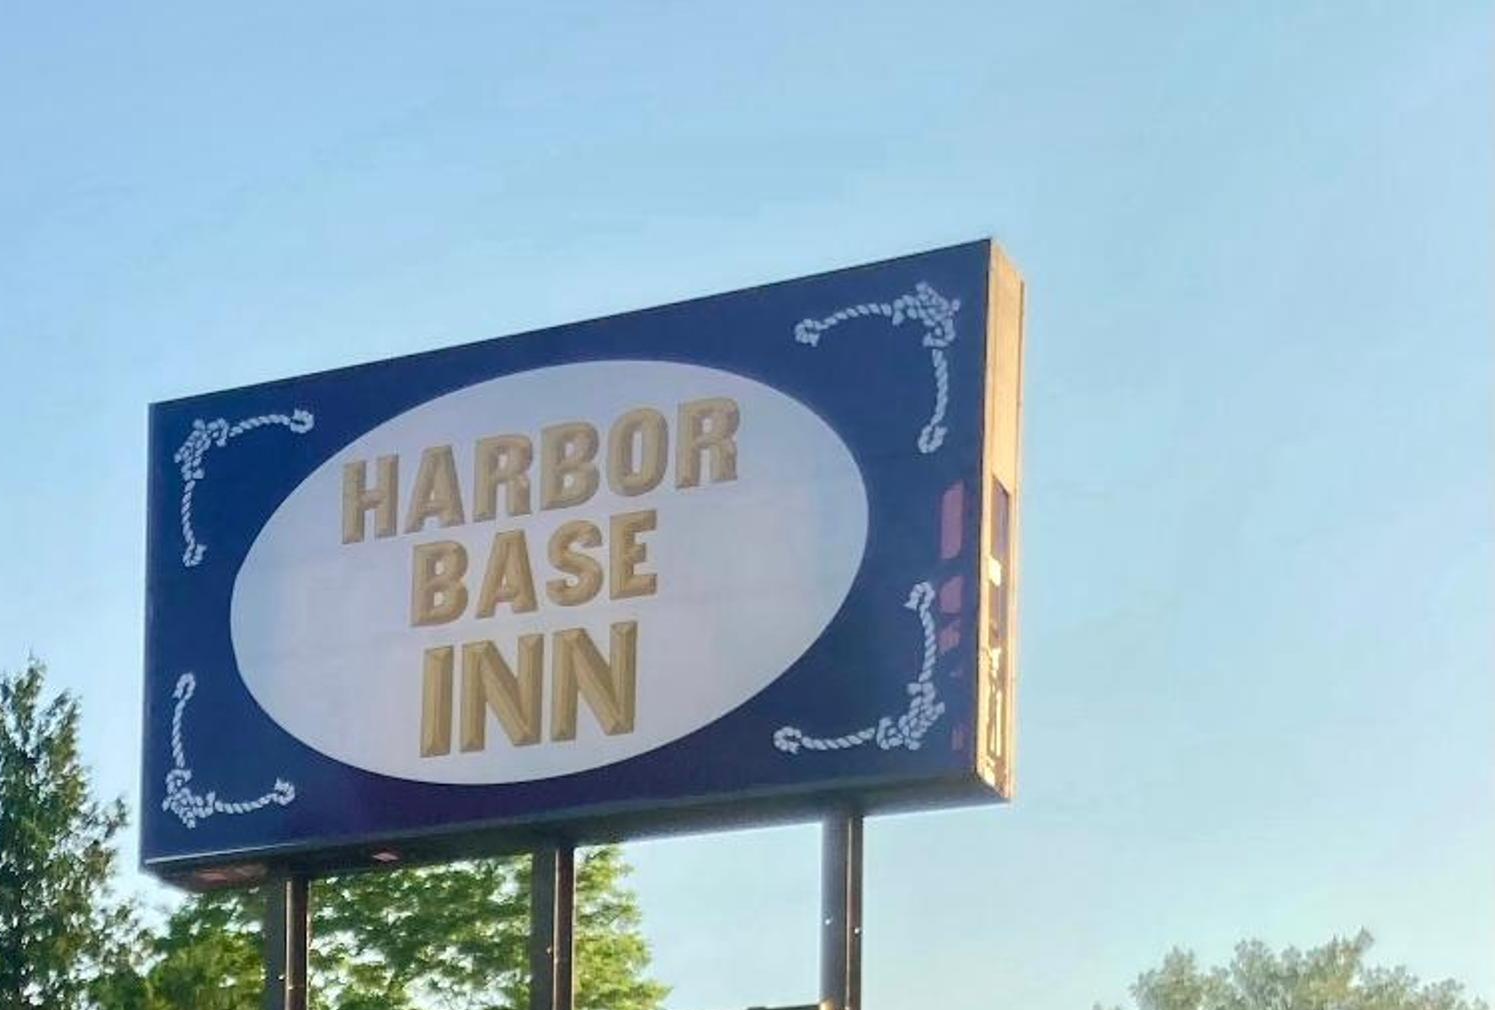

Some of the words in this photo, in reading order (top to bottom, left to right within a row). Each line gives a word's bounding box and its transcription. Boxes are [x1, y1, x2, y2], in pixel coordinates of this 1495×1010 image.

[341, 396, 740, 544] HARBOR
[410, 509, 658, 627] BASE
[419, 620, 638, 758] INN
